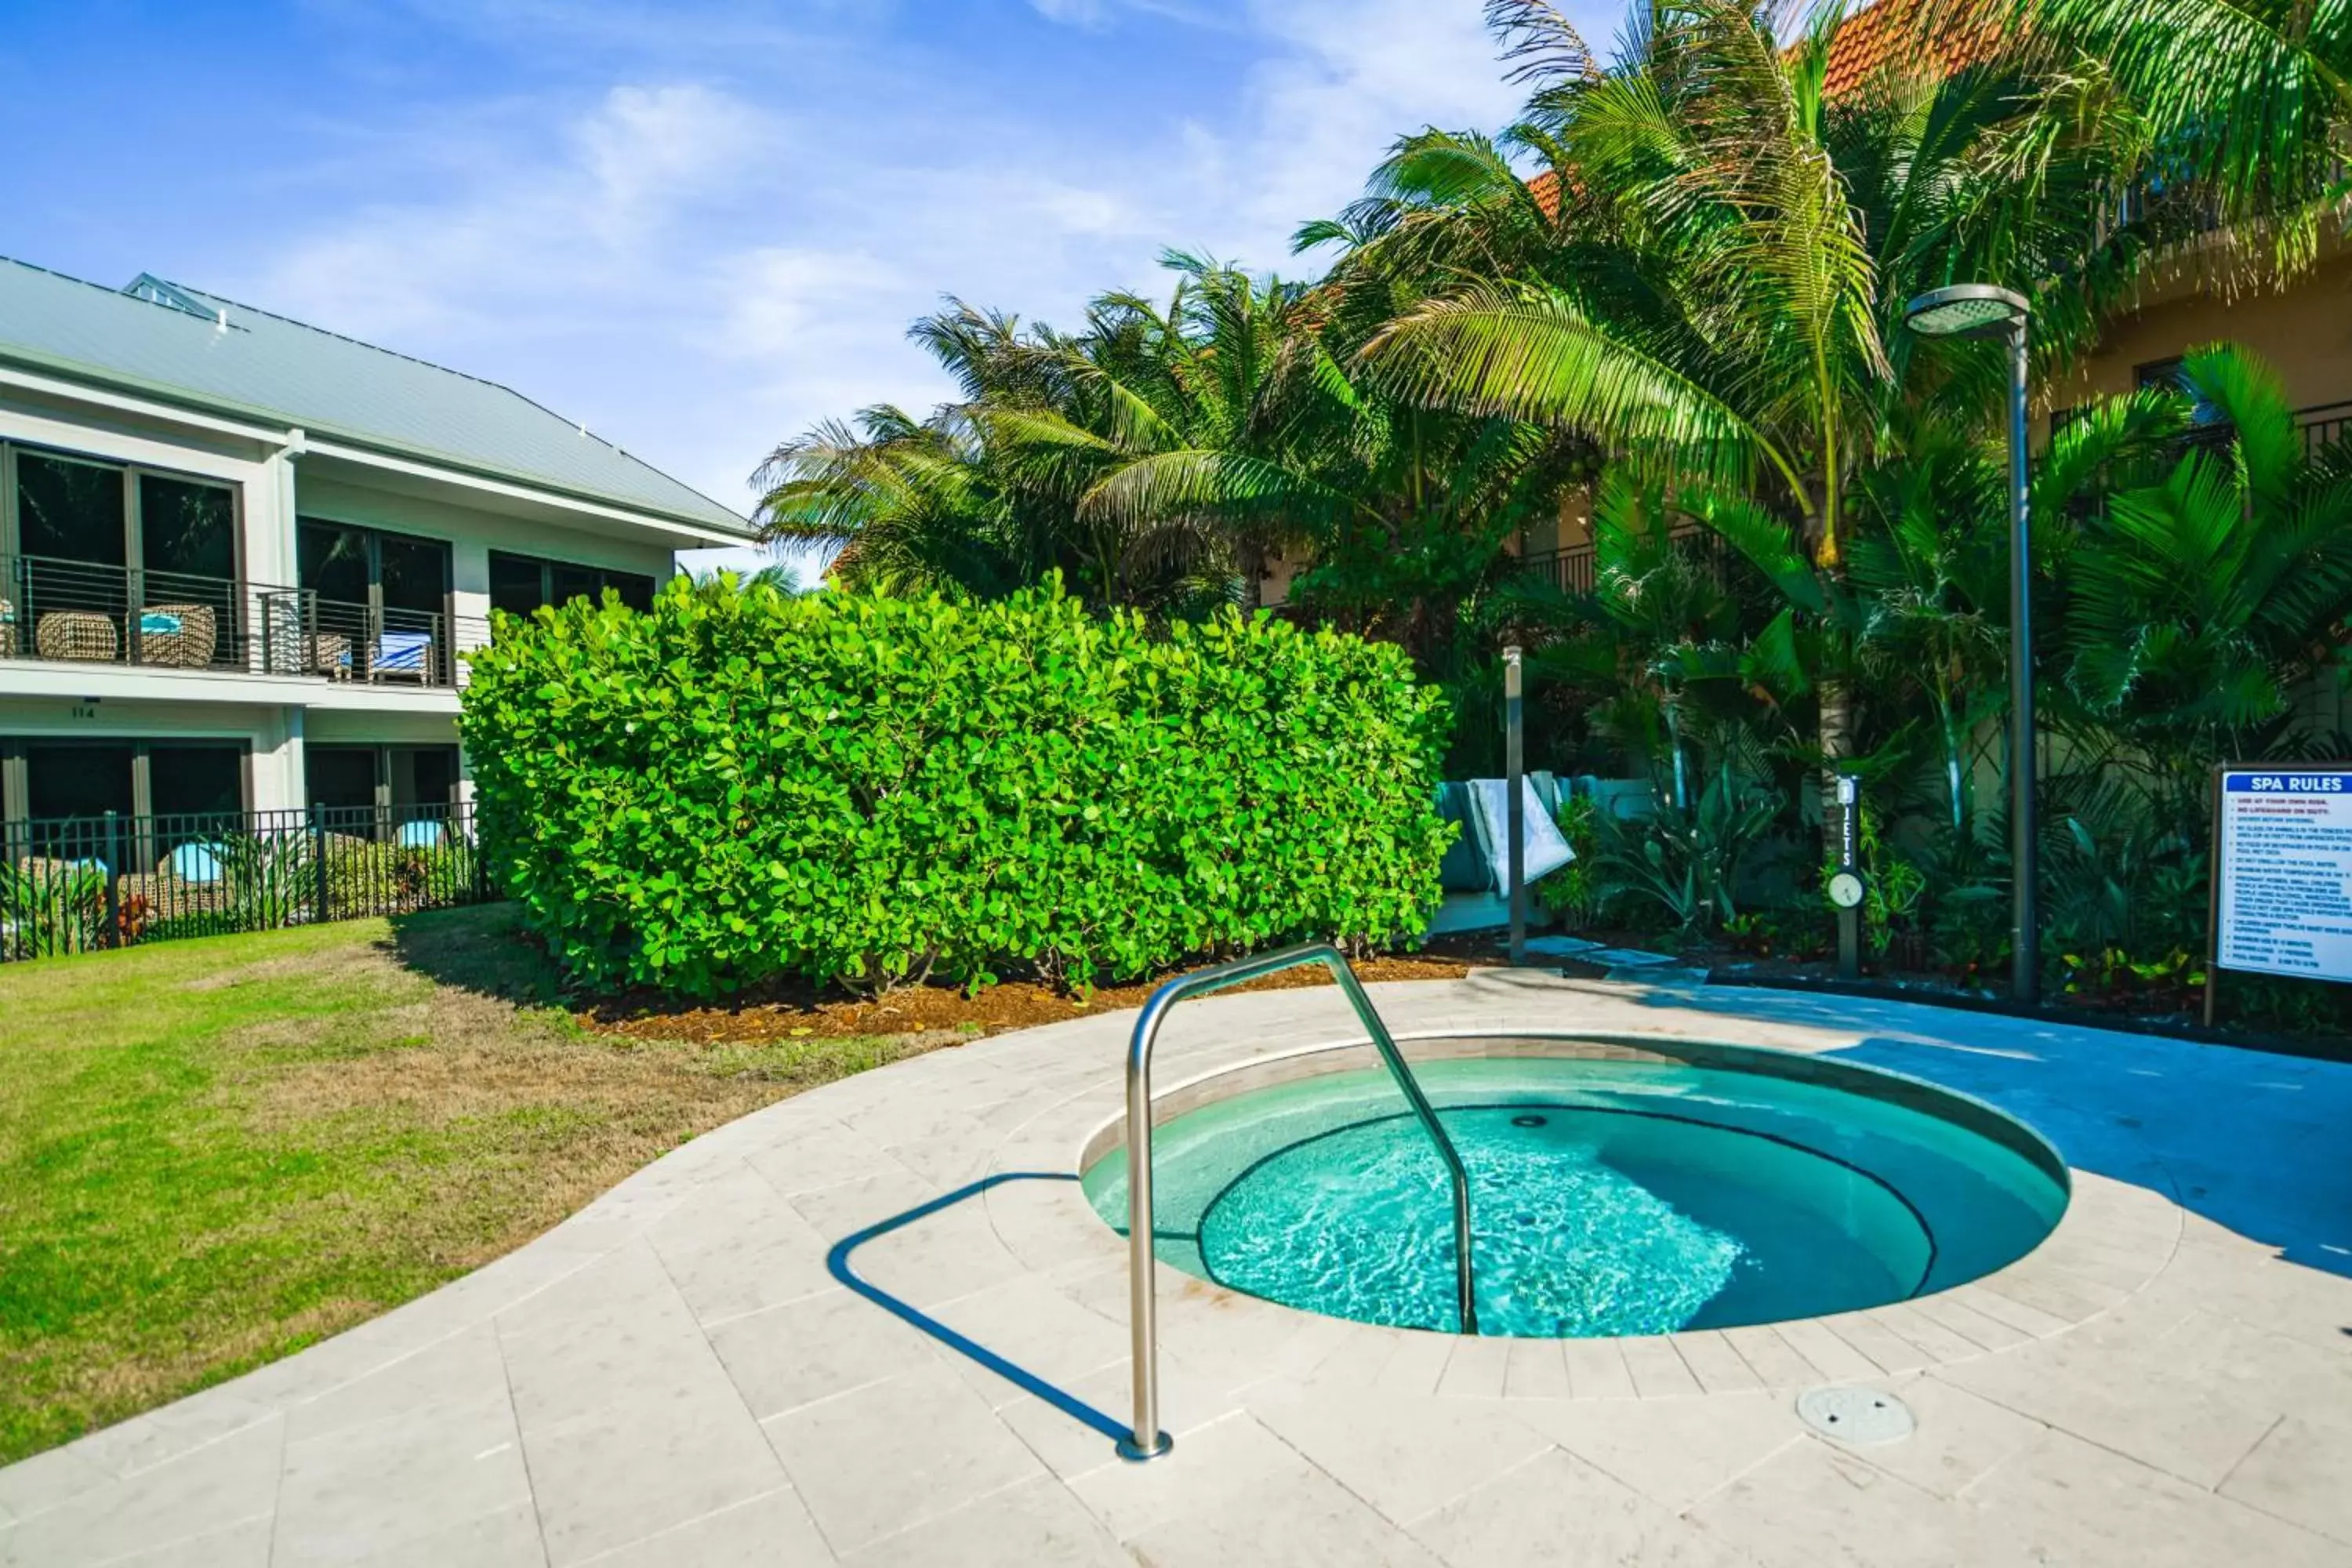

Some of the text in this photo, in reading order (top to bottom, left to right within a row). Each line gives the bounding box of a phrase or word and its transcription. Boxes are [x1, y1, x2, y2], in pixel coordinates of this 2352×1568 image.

[72, 706, 94, 719] 114
[2251, 777, 2343, 791] SPA RULES
